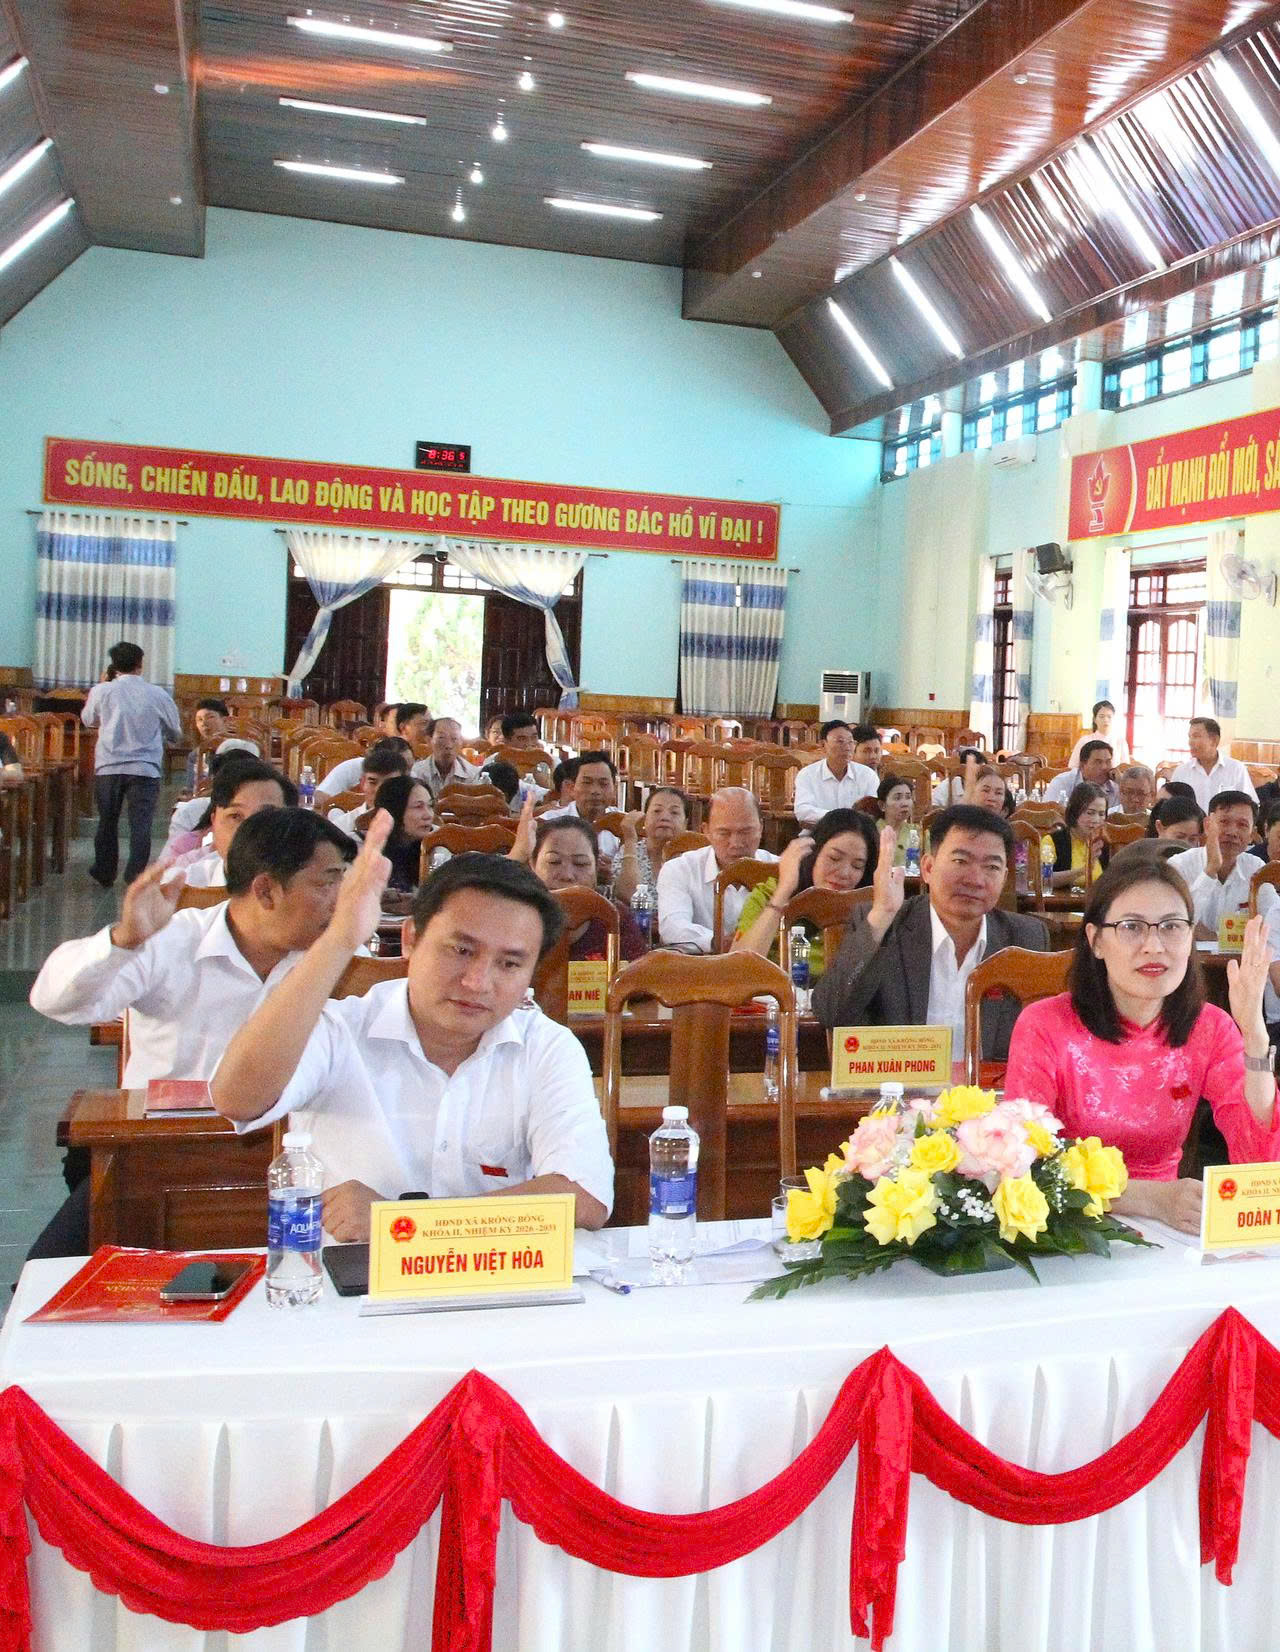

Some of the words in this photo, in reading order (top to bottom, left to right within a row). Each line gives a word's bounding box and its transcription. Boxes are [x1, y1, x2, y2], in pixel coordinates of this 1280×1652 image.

[1146, 446, 1169, 511] ĐẨY
[1170, 455, 1207, 515] MẠNH
[1208, 431, 1230, 501] ĐỔI
[1232, 434, 1260, 498] MỚI,
[65, 451, 133, 493] SỐNG,
[141, 461, 207, 497] CHIẾN
[214, 465, 263, 504] ĐẤU,
[270, 477, 309, 505] LAO
[315, 478, 372, 513] ĐỘNG
[379, 483, 404, 513] VÀ
[411, 490, 451, 521] HỌC
[458, 490, 495, 525] TẬP
[502, 498, 549, 525] THEO
[556, 503, 620, 532] GƯƠNG
[625, 506, 663, 535] BÁC
[669, 507, 693, 538] HỒ
[699, 512, 717, 539] VĨ
[721, 517, 751, 548] ĐẠI
[757, 520, 763, 544] !
[849, 1061, 874, 1074] PHAN
[877, 1058, 902, 1073] XUÂN
[904, 1060, 936, 1073] PHONG
[1237, 1207, 1272, 1228] ĐOÀN
[401, 1247, 467, 1276] NGUYỄN
[473, 1248, 507, 1275] VIỆT
[512, 1245, 544, 1270] HÒA
